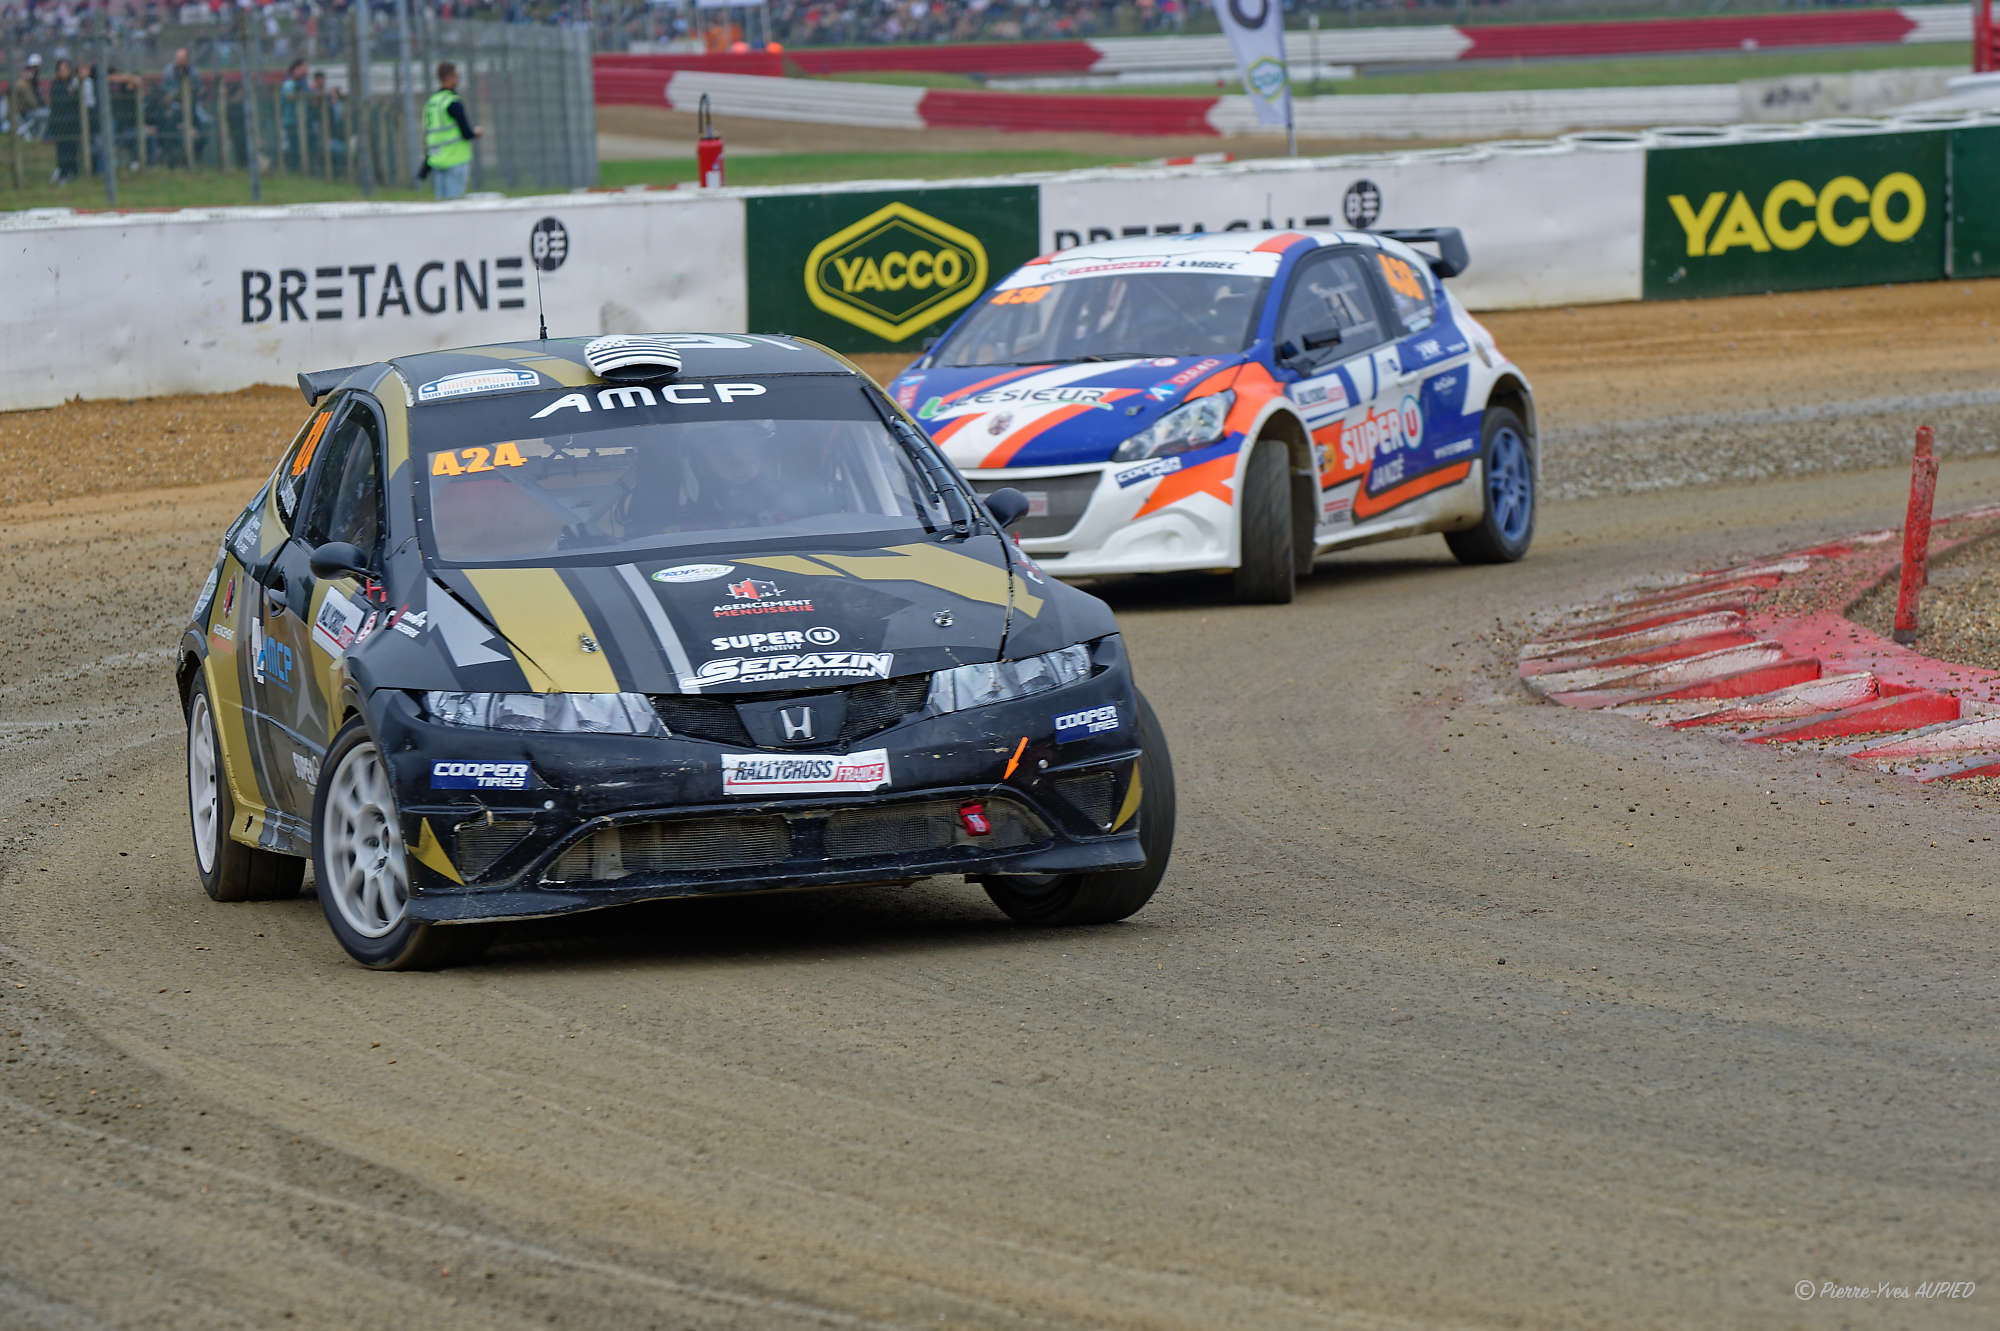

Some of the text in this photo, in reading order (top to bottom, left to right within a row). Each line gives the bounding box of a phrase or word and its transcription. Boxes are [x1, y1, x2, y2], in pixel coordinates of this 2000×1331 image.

[1667, 172, 1926, 257] YACCO
[833, 249, 963, 293] YACCO
[242, 256, 525, 324] BRETAGNE
[444, 387, 474, 396] OUEST
[476, 380, 537, 391] RADIATEURS
[530, 383, 767, 420] AMCP
[1341, 409, 1404, 471] SUPER
[432, 442, 528, 476] 424
[713, 599, 813, 612] AGENCEMENT
[713, 605, 815, 618] MENUISERIE
[711, 631, 806, 651] SUPER
[681, 652, 892, 687] SERAZIN
[740, 668, 877, 683] COMPETITION
[1055, 705, 1118, 731] COOPER
[433, 762, 529, 777] COOPER
[734, 760, 884, 782] RALLYCROSS FRANCE
[477, 777, 525, 788] TIRES
